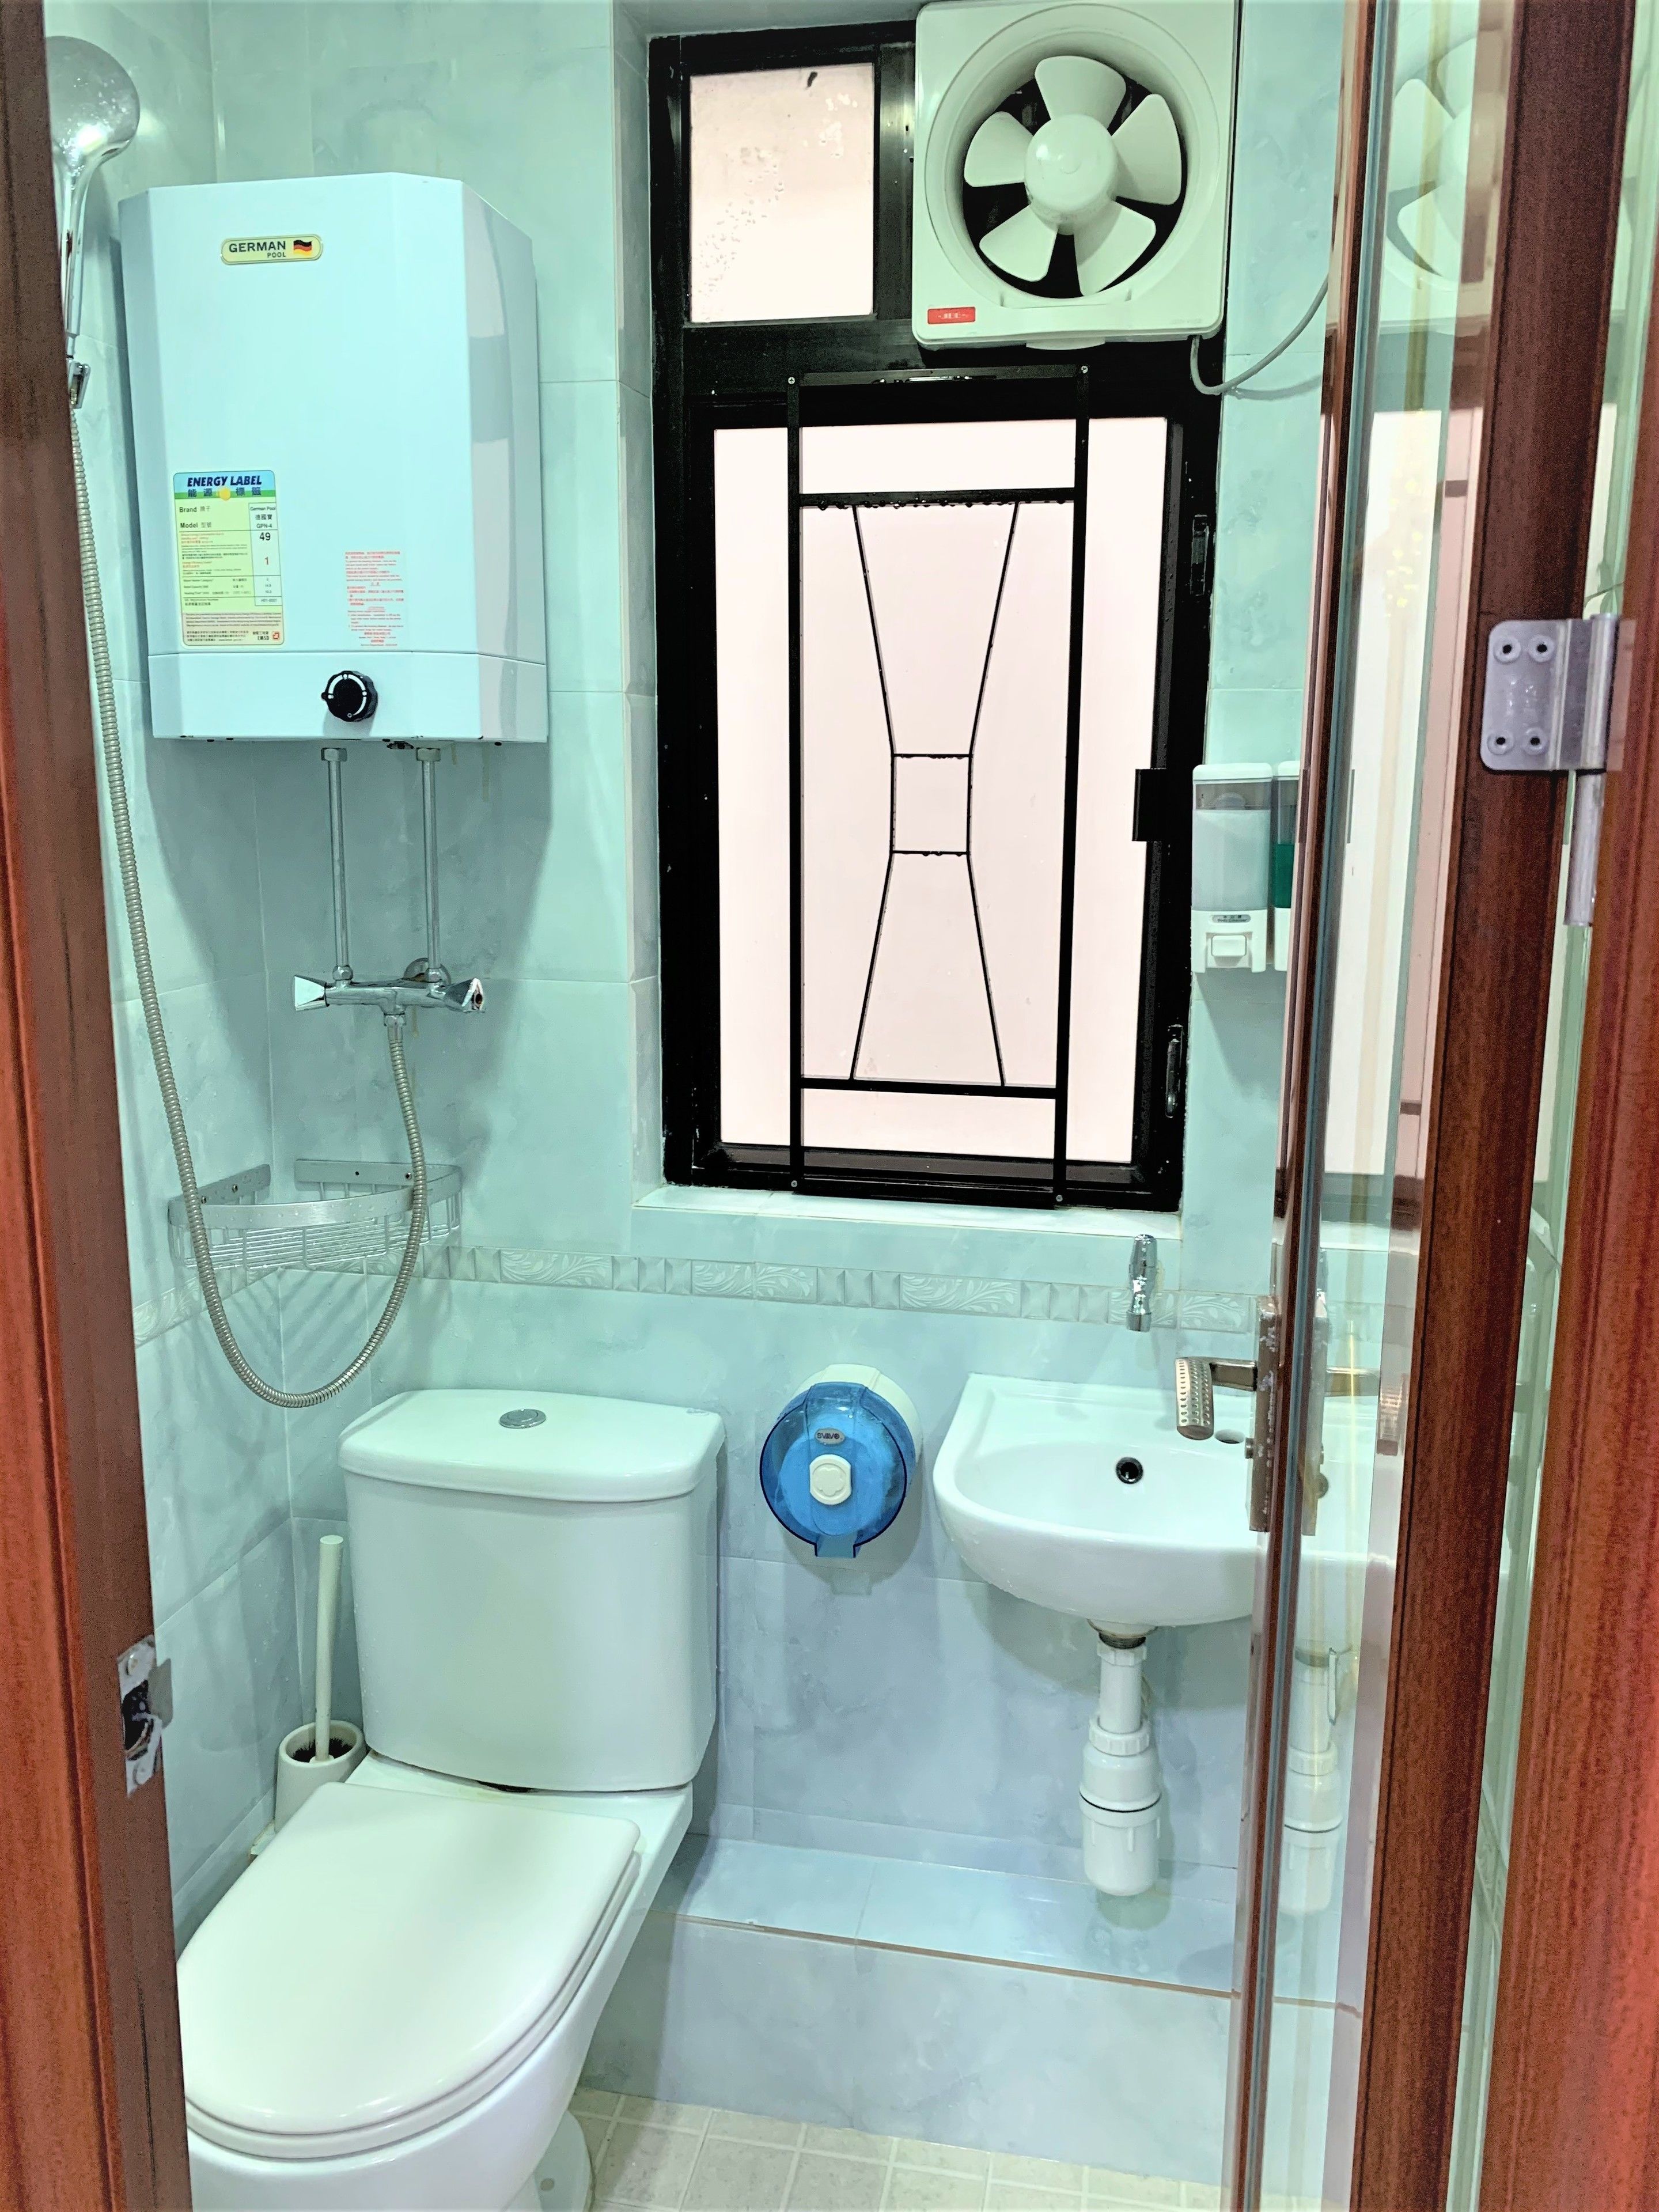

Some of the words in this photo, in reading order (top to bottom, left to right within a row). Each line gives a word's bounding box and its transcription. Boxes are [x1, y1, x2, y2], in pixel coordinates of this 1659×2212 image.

[229, 241, 286, 253] GERMAN
[187, 476, 228, 487] ENERGY
[230, 475, 262, 486] LABEL
[259, 532, 271, 541] 49
[264, 556, 269, 565] 1
